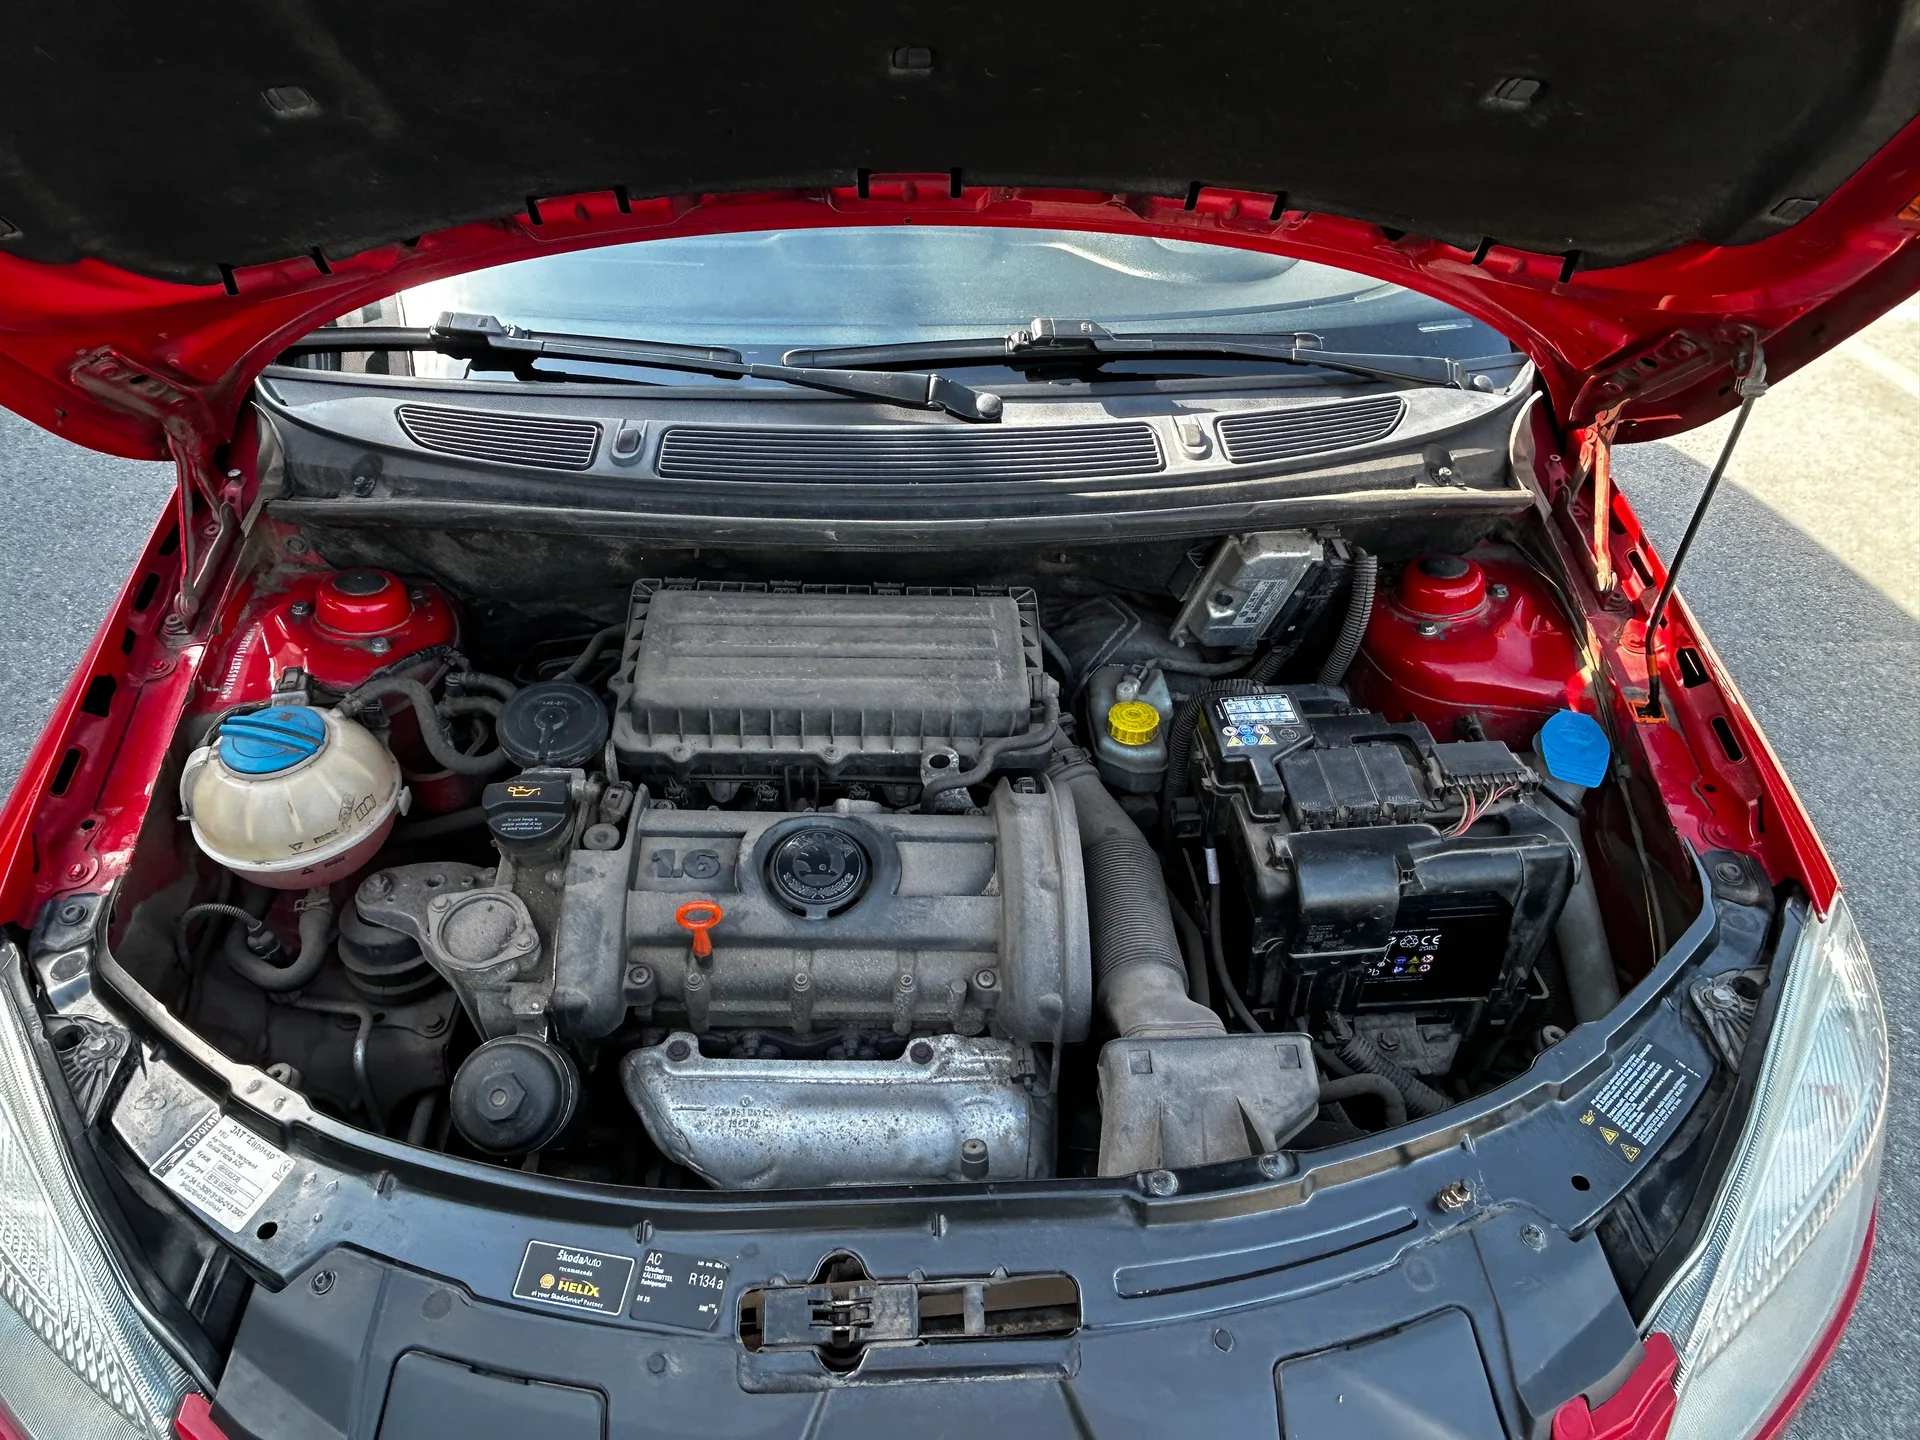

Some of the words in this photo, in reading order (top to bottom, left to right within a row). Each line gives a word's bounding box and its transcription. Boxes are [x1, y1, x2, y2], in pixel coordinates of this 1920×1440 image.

[652, 848, 721, 879] 1.6
[646, 1252, 663, 1266] AC
[557, 1280, 600, 1298] HELIX
